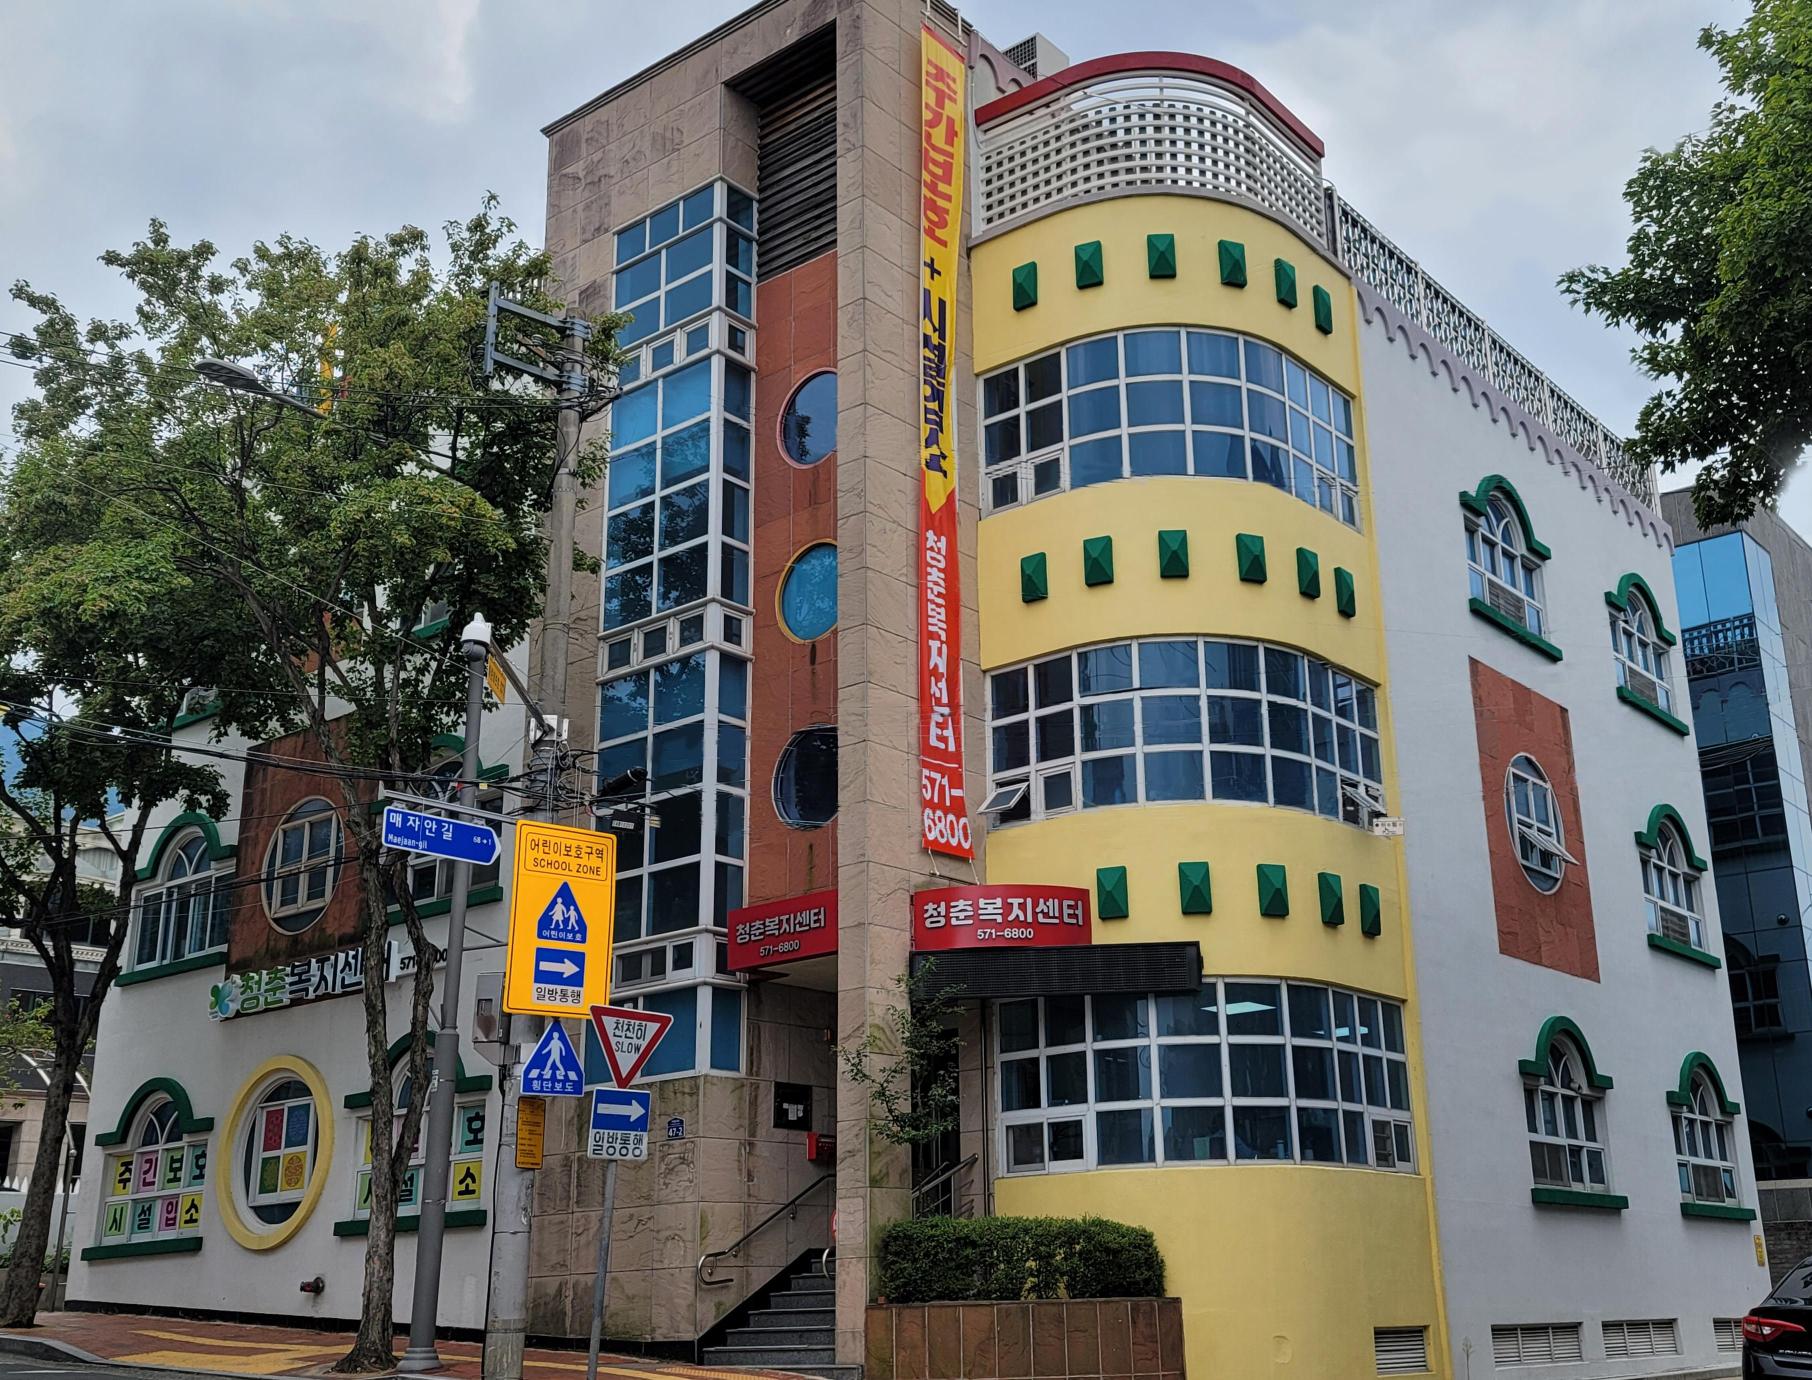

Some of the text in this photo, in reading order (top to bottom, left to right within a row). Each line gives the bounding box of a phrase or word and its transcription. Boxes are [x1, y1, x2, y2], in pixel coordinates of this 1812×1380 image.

[923, 57, 958, 249] 주간보호
[926, 529, 956, 752] 청춘복지센터
[389, 812, 453, 841] 매자안길
[923, 807, 972, 850] 6800
[387, 833, 428, 849] Maejaan-gil
[530, 838, 604, 863] 어린이보호구역
[533, 857, 601, 876] SCHOOL ZONE
[923, 897, 1084, 929] 청춘복지센터
[542, 929, 582, 940] 어린이보호
[736, 906, 825, 943] 청춘복지센터
[977, 928, 1034, 940] 571-6800
[760, 940, 800, 957] 571-6800
[535, 986, 581, 1004] 일방통행
[613, 1019, 648, 1041] 천천히
[614, 1040, 642, 1055] SLOW
[531, 1079, 574, 1092] 횡단보도
[668, 1126, 683, 1137] 47-2
[592, 1130, 644, 1158] 일방통행
[108, 1198, 199, 1232] 시설입소
